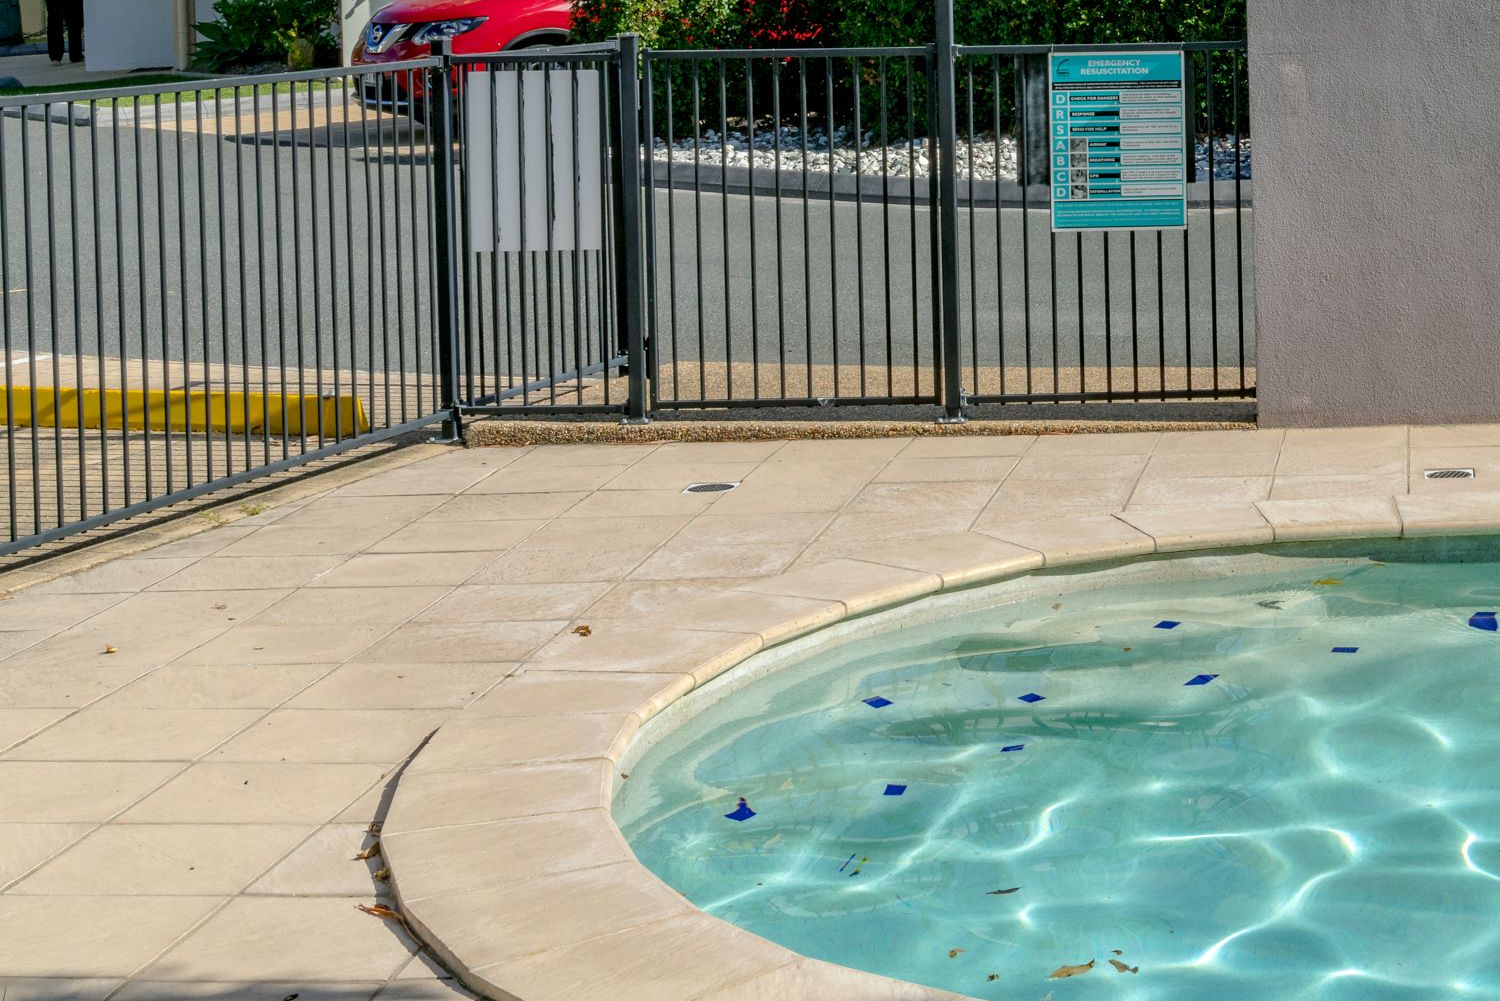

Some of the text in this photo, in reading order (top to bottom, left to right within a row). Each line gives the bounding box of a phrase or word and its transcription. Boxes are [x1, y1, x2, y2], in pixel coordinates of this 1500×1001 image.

[1087, 59, 1141, 67] EMERGENCY
[1080, 67, 1149, 75] RESUSCITATION
[1056, 94, 1066, 104] D
[1056, 110, 1064, 119] R
[1056, 125, 1064, 135] S
[1056, 141, 1066, 151] A
[1056, 156, 1066, 166] B
[1056, 171, 1066, 182] C
[1056, 187, 1067, 197] D
